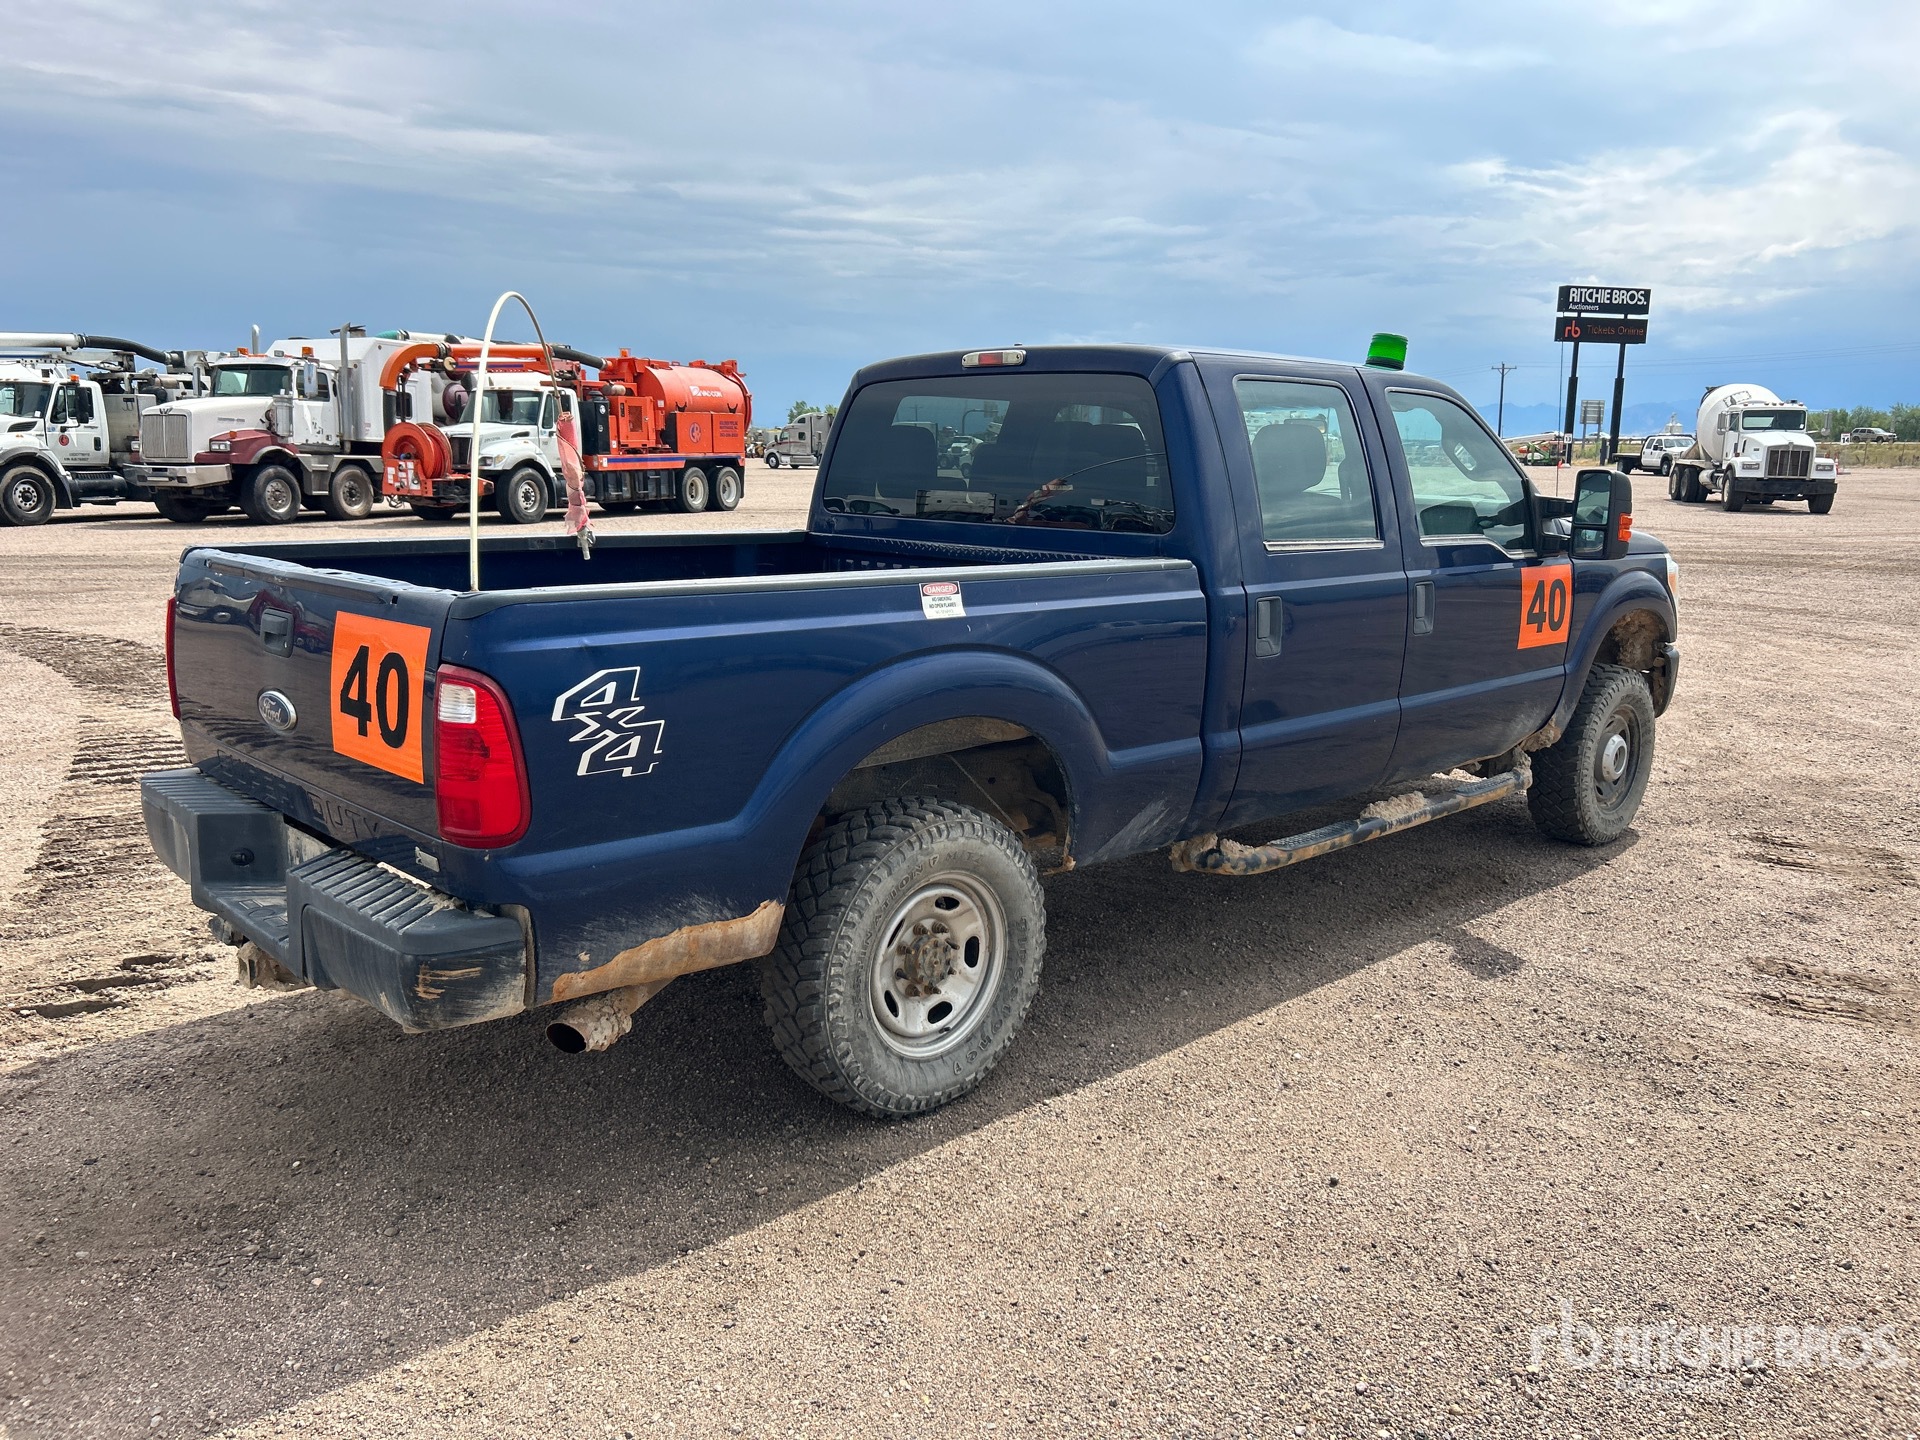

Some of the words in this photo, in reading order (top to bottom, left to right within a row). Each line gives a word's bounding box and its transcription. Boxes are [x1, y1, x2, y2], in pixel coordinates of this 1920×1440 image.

[1569, 288, 1611, 303] RITCHIE
[1612, 290, 1647, 305] BROS.
[1569, 303, 1600, 311] Auctioneers
[1564, 320, 1581, 338] rb
[1586, 325, 1615, 335] Tickets
[1617, 326, 1644, 336] Online
[1526, 579, 1567, 634] 40
[340, 645, 410, 750] 40
